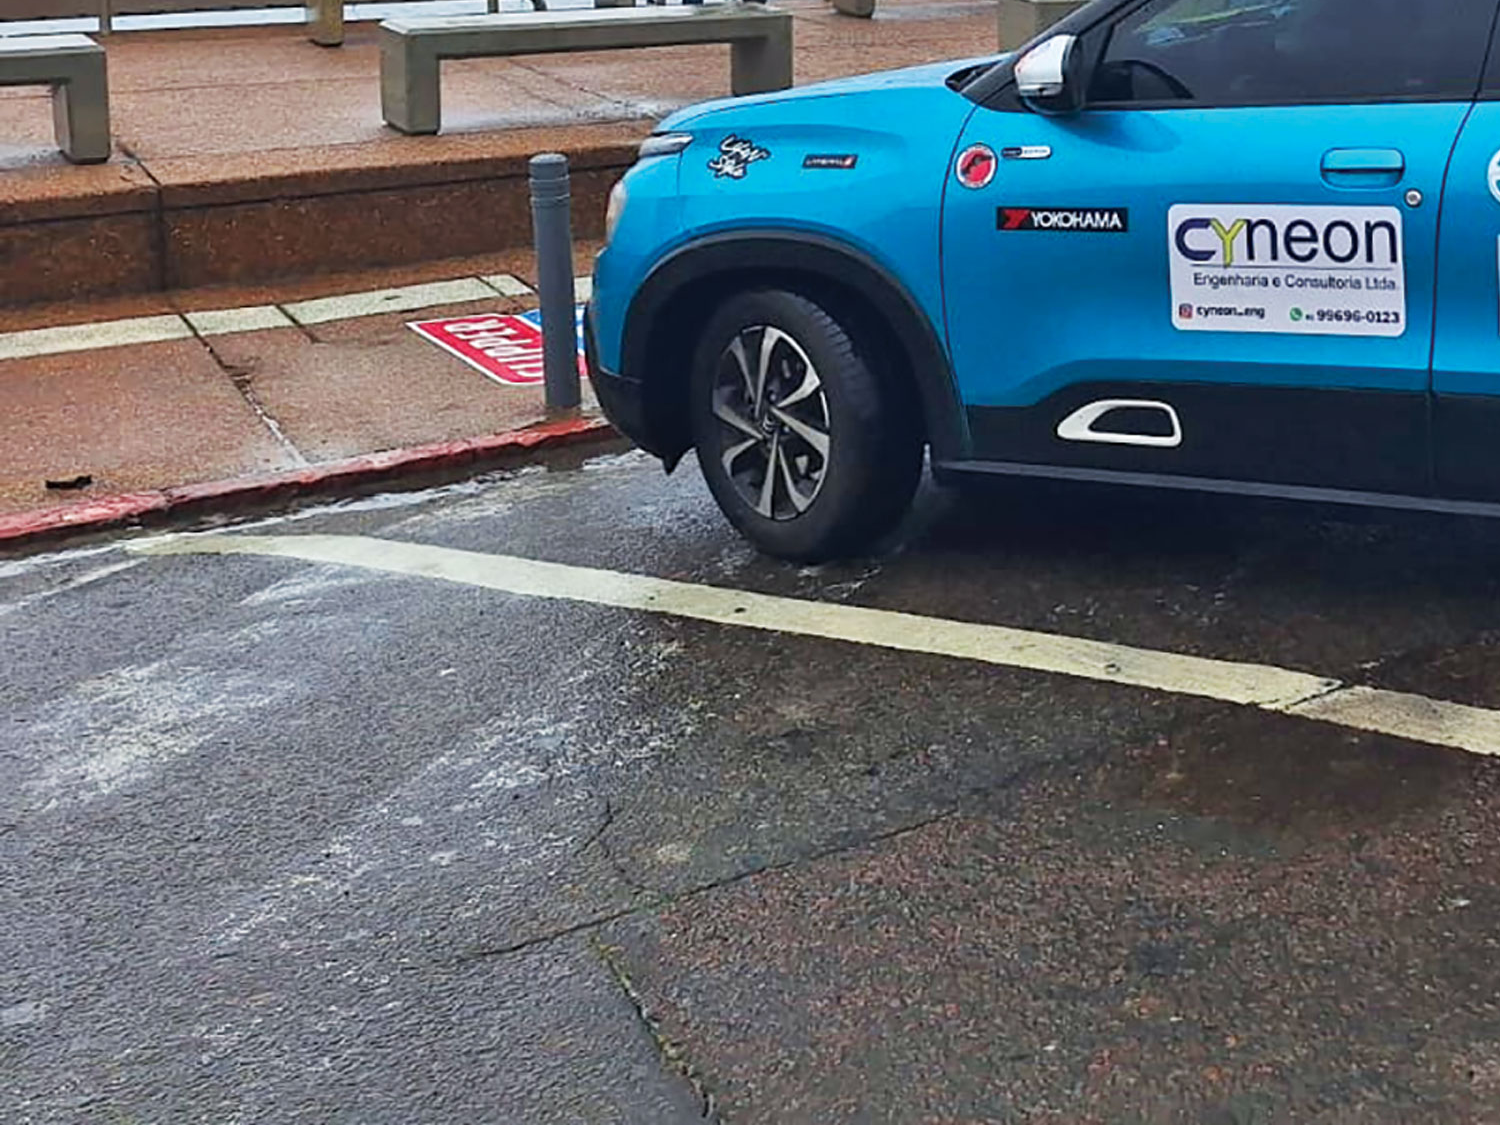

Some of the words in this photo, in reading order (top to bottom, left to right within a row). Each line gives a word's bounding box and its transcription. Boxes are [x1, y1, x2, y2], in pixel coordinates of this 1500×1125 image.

[1031, 211, 1123, 229] YOKOHAMA
[1193, 272, 1268, 290] Engenharia
[1272, 277, 1281, 288] e
[1284, 274, 1362, 289] Consultoria
